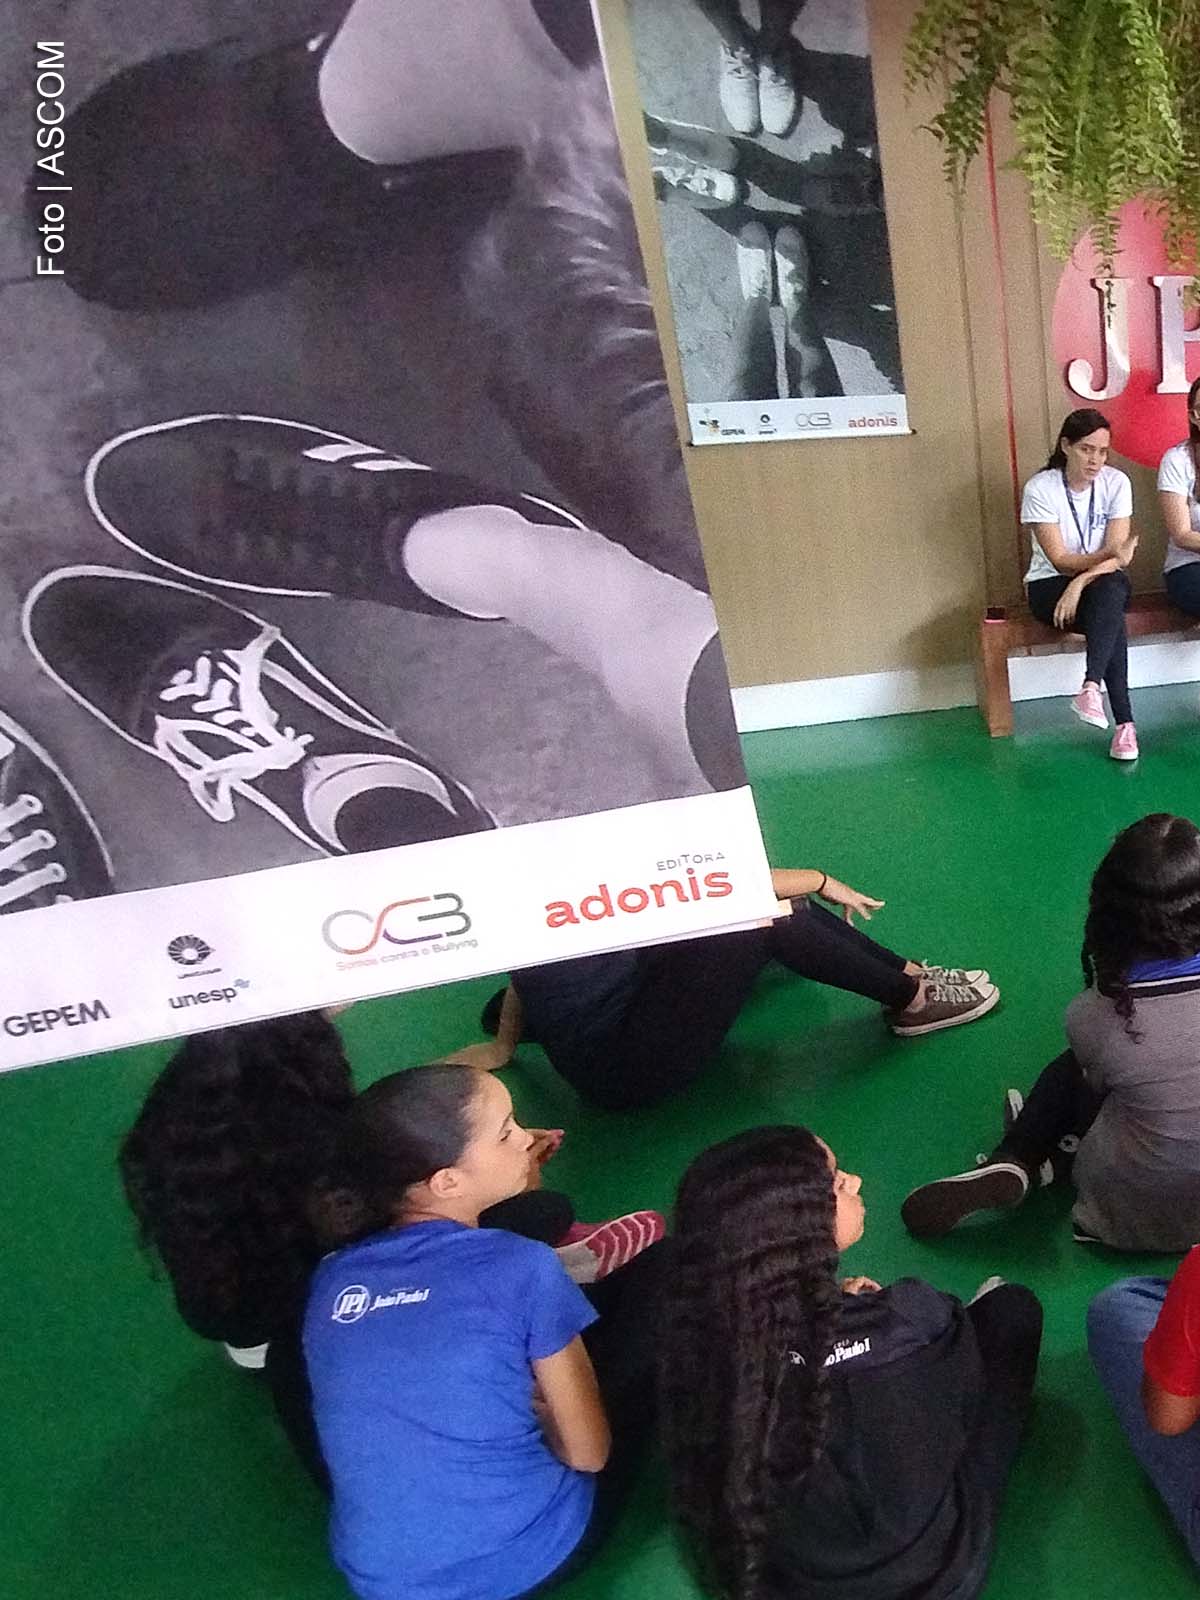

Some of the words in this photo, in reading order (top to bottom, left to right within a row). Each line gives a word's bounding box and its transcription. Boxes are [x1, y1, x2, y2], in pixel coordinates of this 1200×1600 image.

[848, 416, 898, 428] adonis
[656, 851, 726, 871] EDITORA
[545, 867, 734, 928] adonis
[168, 986, 237, 1009] unesp
[3, 999, 111, 1037] GEPEM
